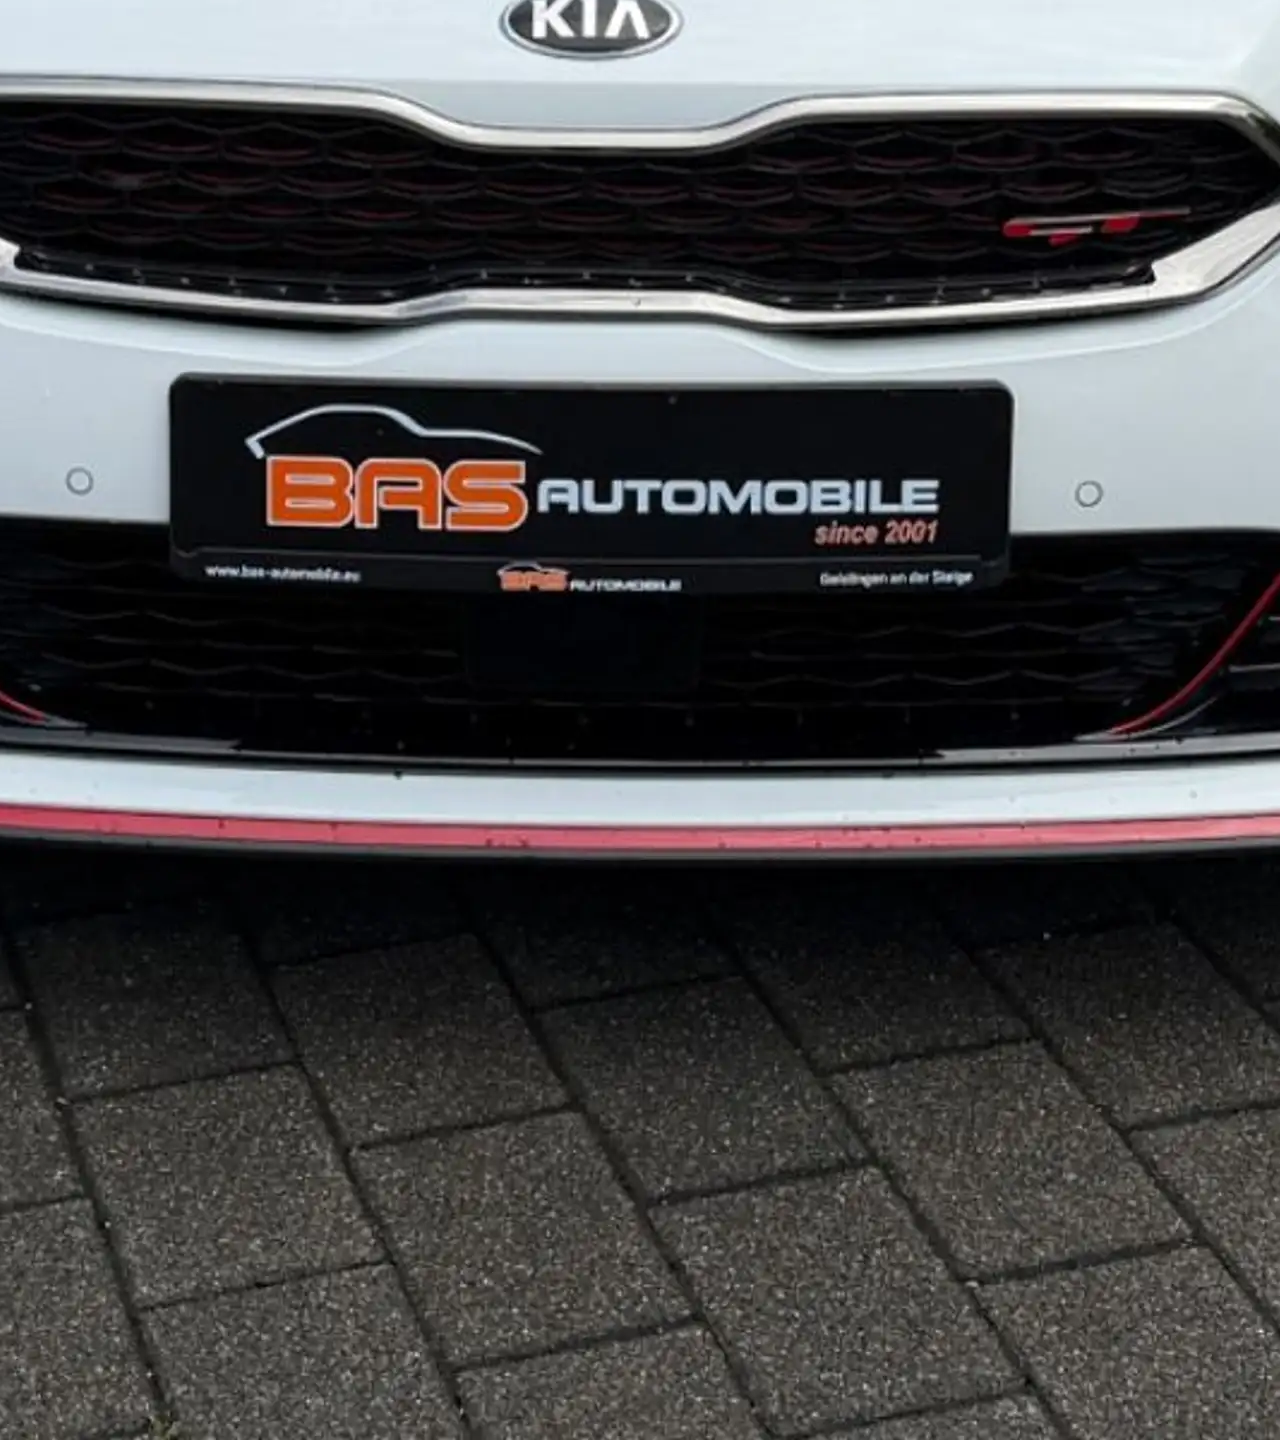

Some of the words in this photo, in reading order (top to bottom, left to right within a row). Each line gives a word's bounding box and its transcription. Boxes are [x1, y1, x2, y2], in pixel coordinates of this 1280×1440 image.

[266, 455, 529, 532] BAS
[537, 479, 940, 515] AUTOMOBILE
[814, 520, 879, 546] since
[884, 518, 939, 546] 2001
[571, 578, 683, 593] AUTOMOBILE
[890, 572, 907, 585] an
